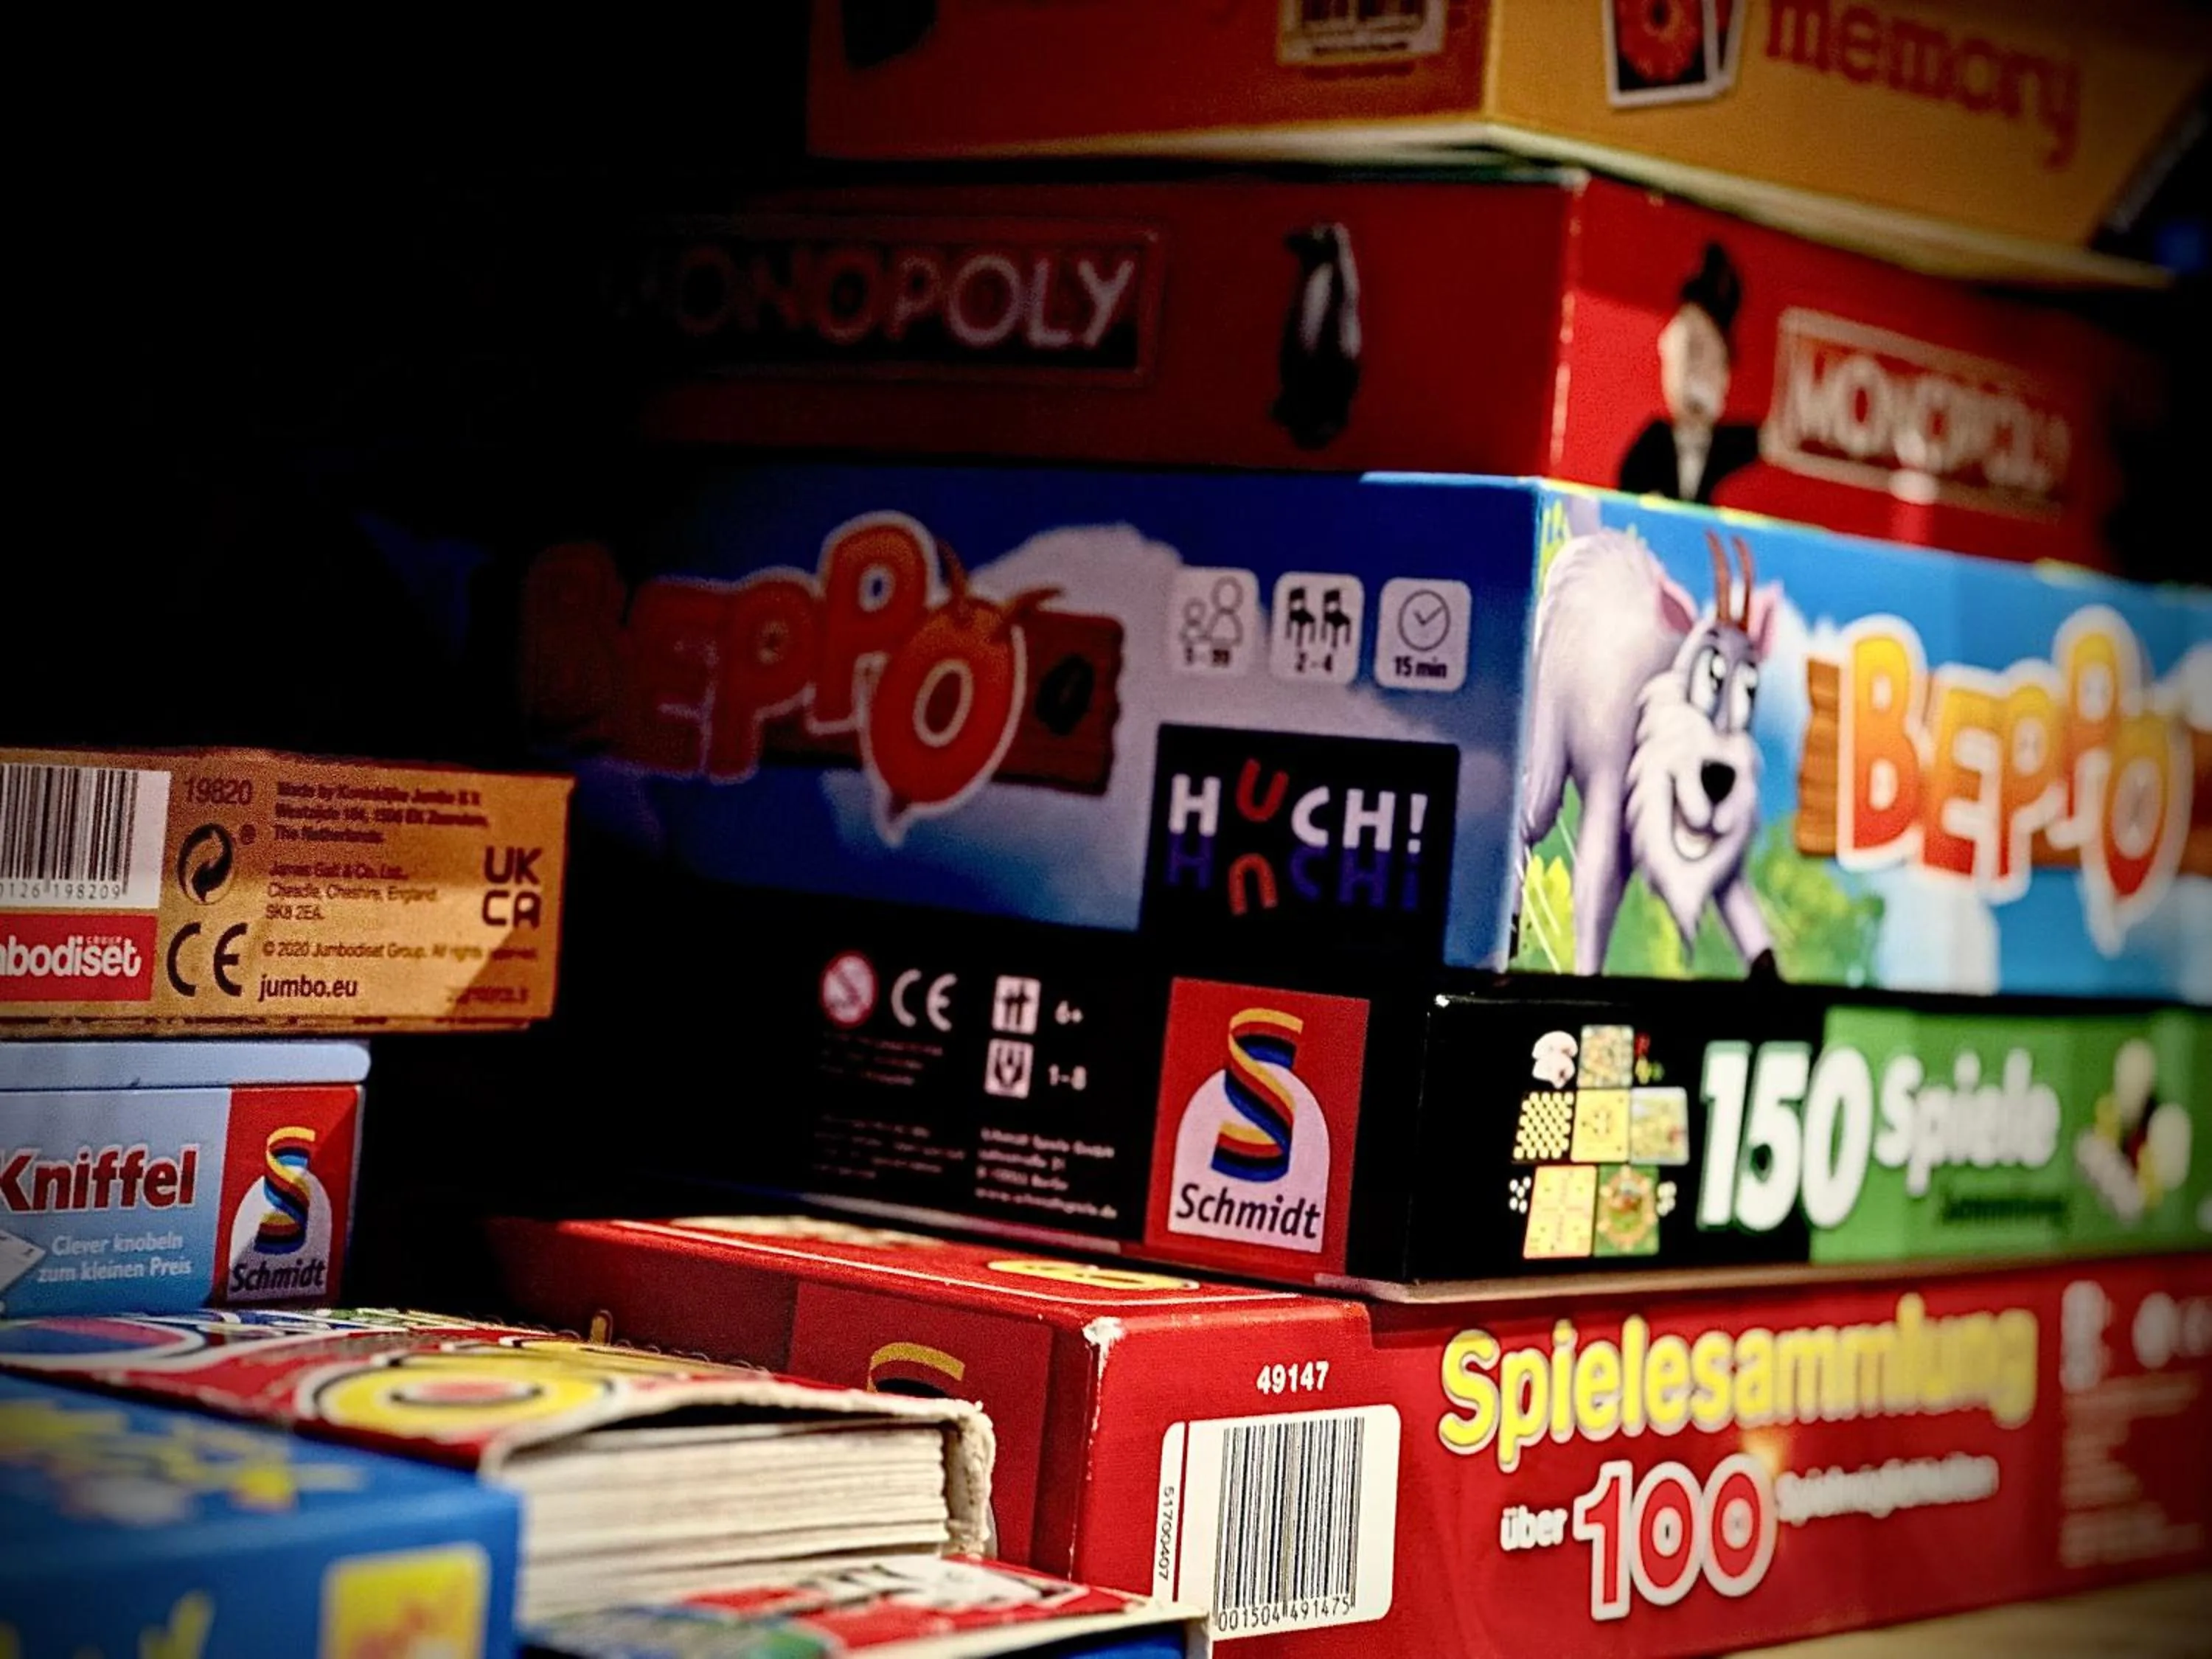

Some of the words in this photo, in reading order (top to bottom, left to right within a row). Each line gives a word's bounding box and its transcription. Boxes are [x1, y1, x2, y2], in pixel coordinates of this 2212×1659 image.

[1765, 0, 2084, 170] memory
[649, 237, 1137, 349] ONOPOLY
[184, 777, 254, 805] 19820
[1169, 758, 1428, 855] HUCH!
[1836, 611, 2193, 956] BEPPO
[485, 846, 543, 886] UK
[481, 889, 541, 929] CA
[166, 922, 248, 998] CE
[257, 974, 358, 1003] jumbo.eu
[891, 967, 958, 1032] CE
[1697, 1041, 1874, 1231] 150
[1874, 1047, 2062, 1197] Spiele
[0, 1143, 199, 1214] Kniffel
[1176, 1182, 1322, 1239] Schmidt
[38, 1265, 74, 1283] zum
[80, 1259, 145, 1280] kleinen
[149, 1256, 192, 1277] Preis
[52, 1234, 108, 1256] Clever
[114, 1231, 184, 1253] knobeln
[231, 1259, 327, 1293] Schmidt
[1256, 1360, 1330, 1394] 49147
[1438, 1292, 2038, 1473] Spielesammlung
[1157, 1485, 1175, 1582] 51700407
[1500, 1506, 1569, 1551] über
[1572, 1453, 1777, 1621] 100
